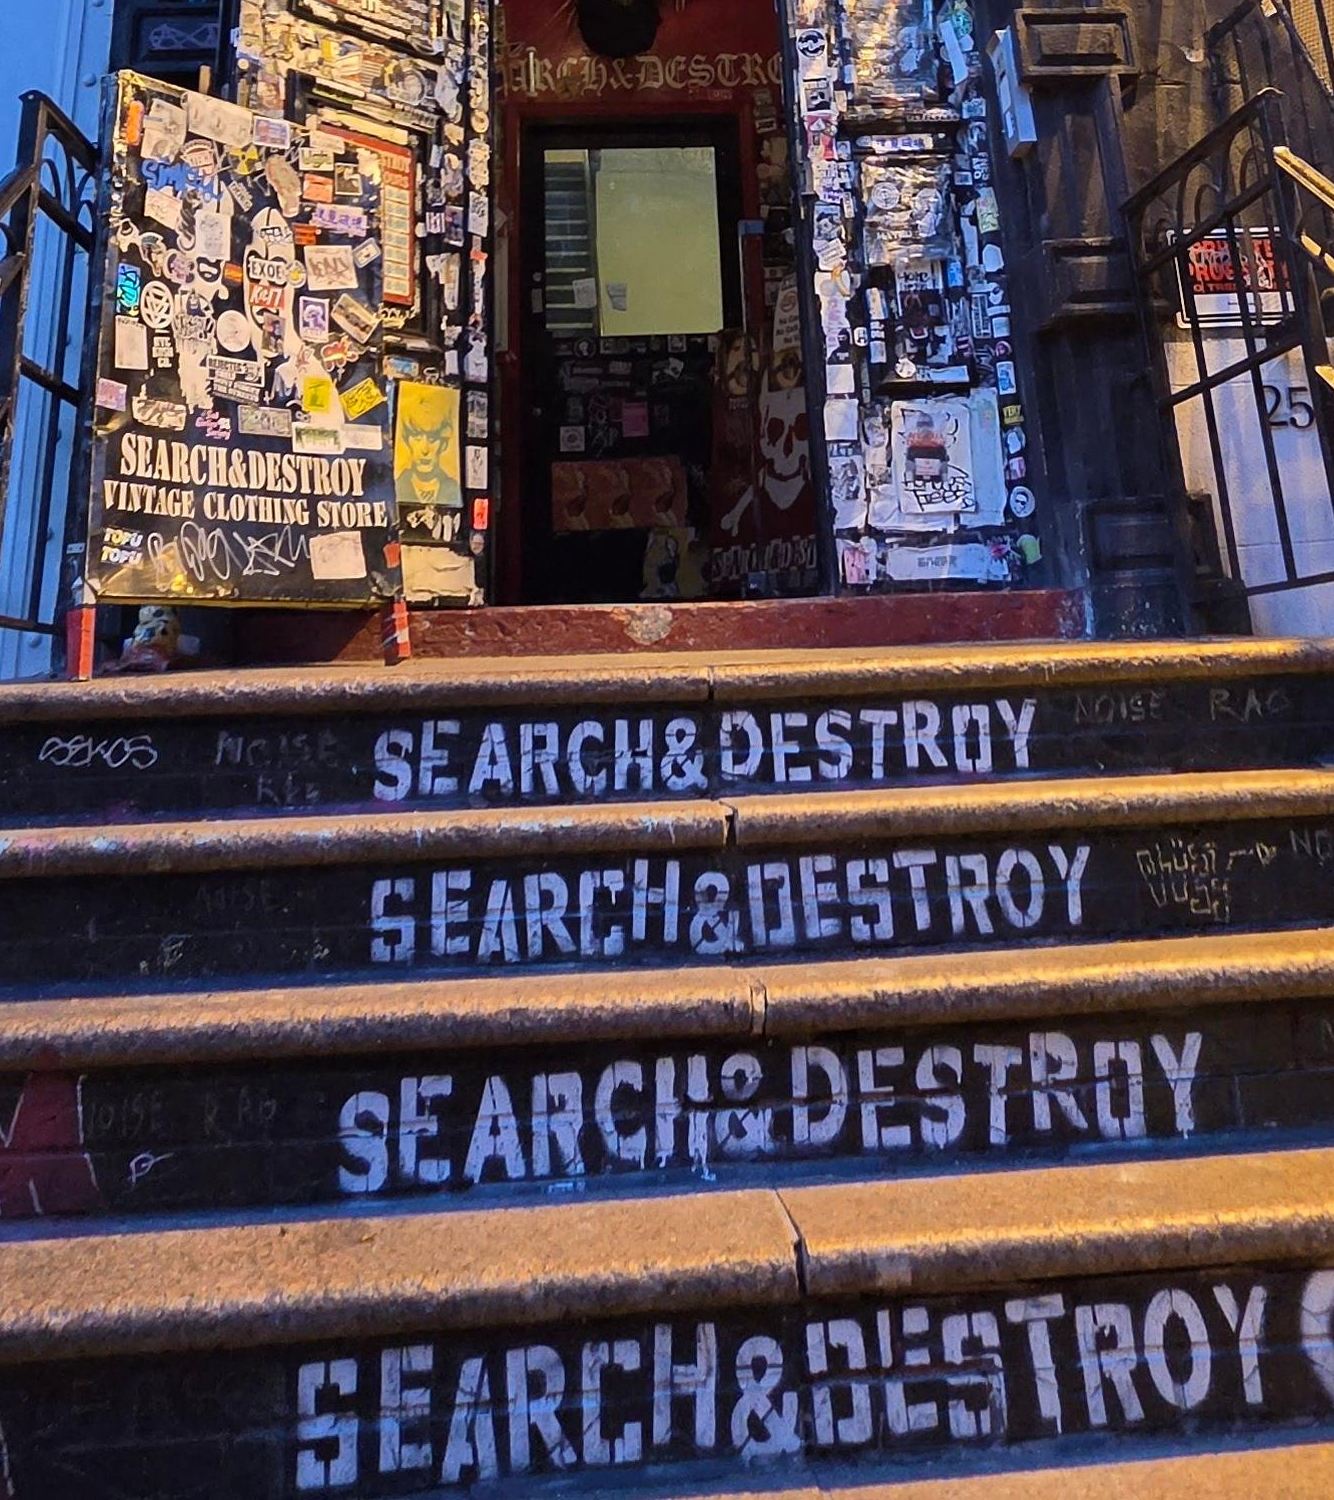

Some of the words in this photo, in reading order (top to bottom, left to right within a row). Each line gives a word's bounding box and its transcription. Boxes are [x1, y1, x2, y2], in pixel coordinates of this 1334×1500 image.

[1262, 384, 1315, 430] 25
[103, 479, 196, 519] VINTAGE
[202, 491, 310, 527] CLOTHING
[317, 500, 389, 530] STORE
[104, 526, 144, 548] TOFU
[100, 545, 144, 566] TOFU
